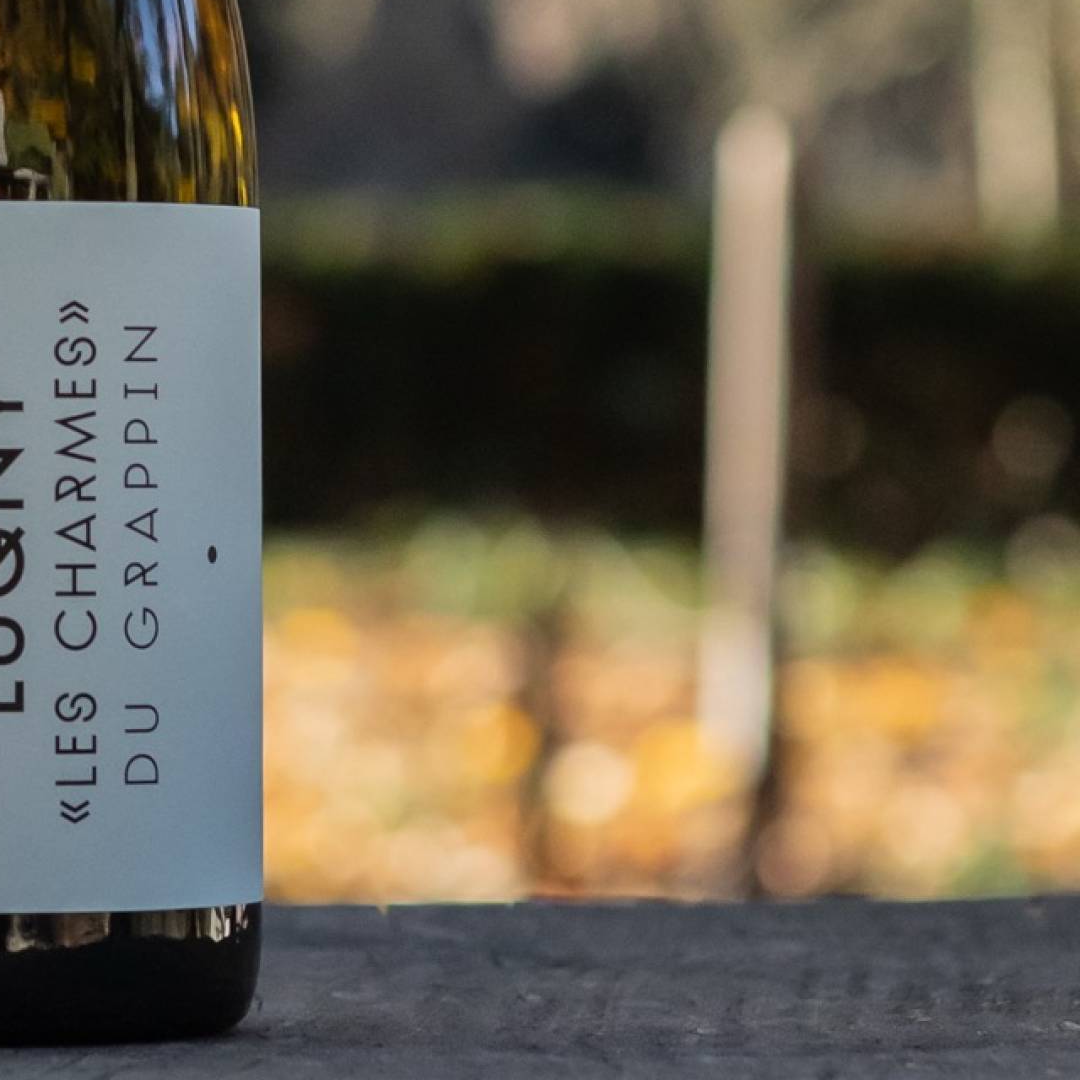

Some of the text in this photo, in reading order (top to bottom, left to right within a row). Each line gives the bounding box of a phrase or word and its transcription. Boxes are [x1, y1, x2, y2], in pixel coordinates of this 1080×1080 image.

[53, 299, 97, 825] «LES CHARMES»
[123, 325, 160, 786] DU GRAPPIN
